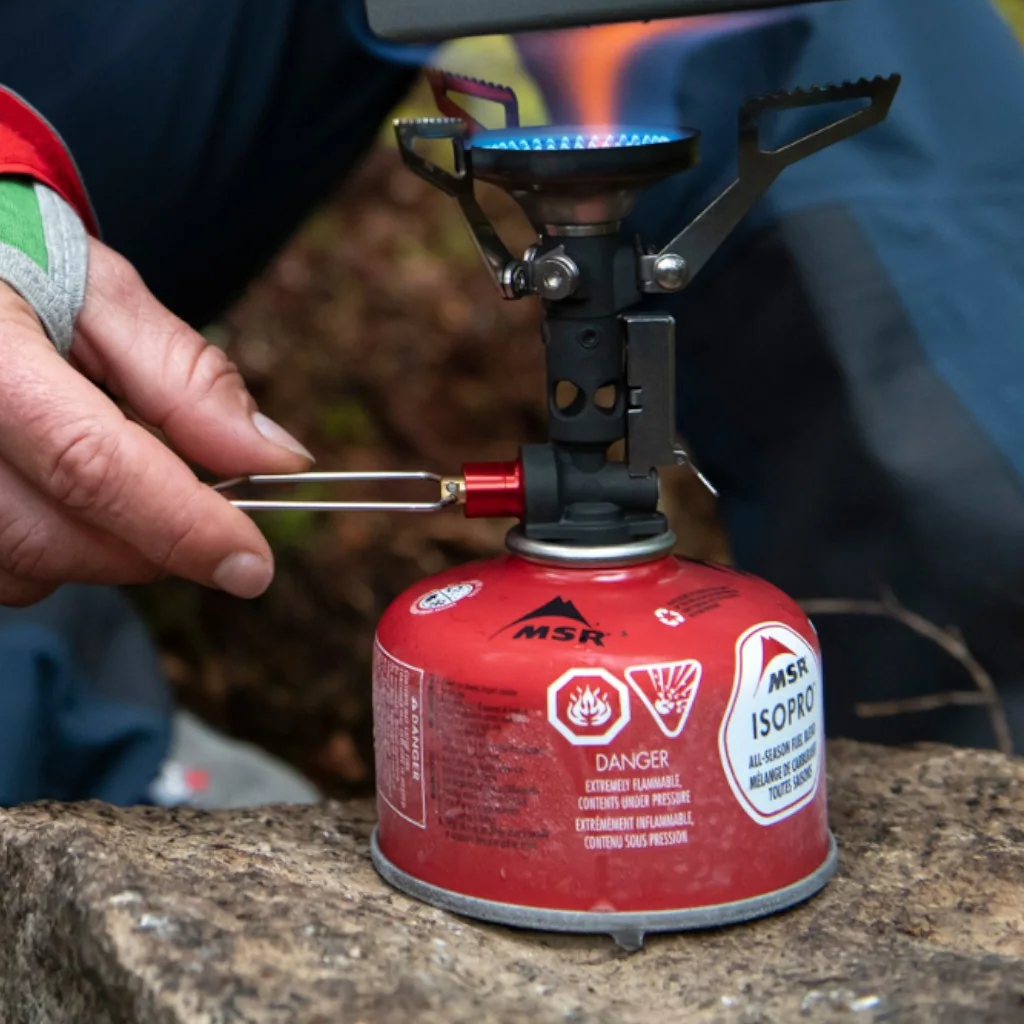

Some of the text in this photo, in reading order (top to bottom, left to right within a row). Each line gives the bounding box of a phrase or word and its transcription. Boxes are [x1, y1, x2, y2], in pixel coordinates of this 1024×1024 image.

[512, 625, 605, 648] MSR
[768, 657, 809, 694] MSR
[751, 684, 814, 740] ISOPRO
[411, 713, 420, 781] DANGER
[749, 740, 791, 769] ALL-SEASON
[791, 733, 804, 751] FUEL
[595, 749, 670, 772] DANGER
[585, 774, 683, 793] EXTREMELY FLAMMABLE,
[749, 766, 782, 790] MÉLANGE
[782, 761, 791, 777] DE
[768, 762, 813, 801] TOUTES SAISONS
[578, 790, 691, 810] CONTENTS UNDER PRESSURE
[636, 811, 694, 830] INFLAMMABLE,
[584, 830, 688, 850] CONTENU SOUS PRESSION
